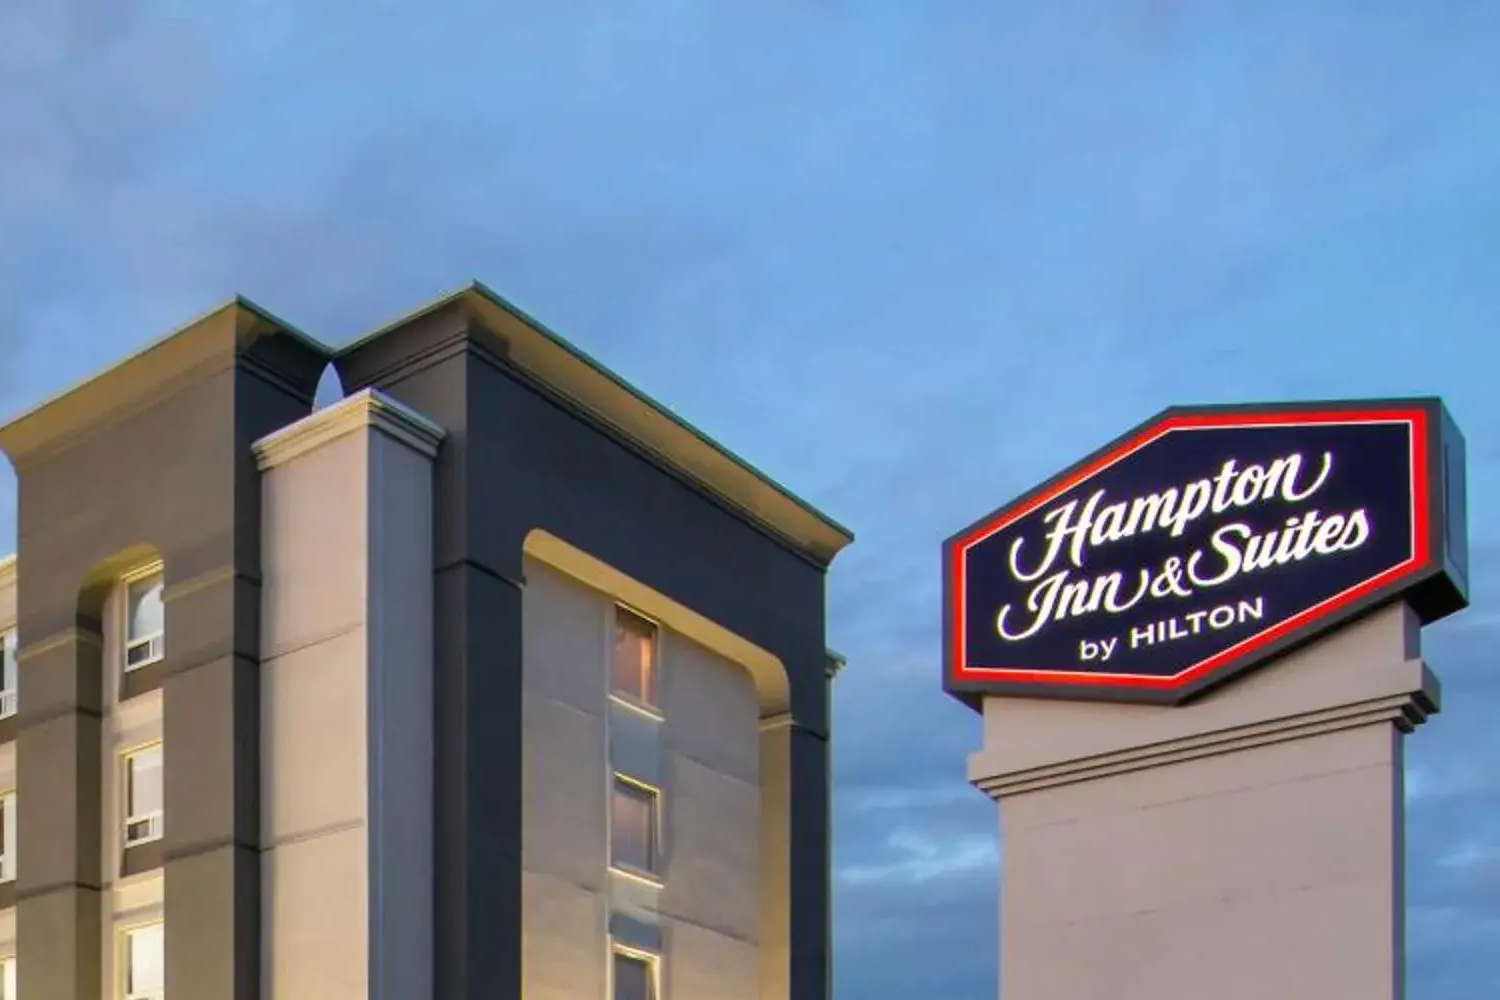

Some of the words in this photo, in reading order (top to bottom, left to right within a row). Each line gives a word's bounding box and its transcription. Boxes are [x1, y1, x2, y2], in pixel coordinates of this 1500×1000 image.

[997, 569, 1150, 641] Inn
[1150, 556, 1193, 598] &
[1187, 508, 1370, 587] Suites
[1009, 451, 1332, 582] Hampton
[1080, 637, 1118, 662] by
[1131, 597, 1263, 649] HILTON
